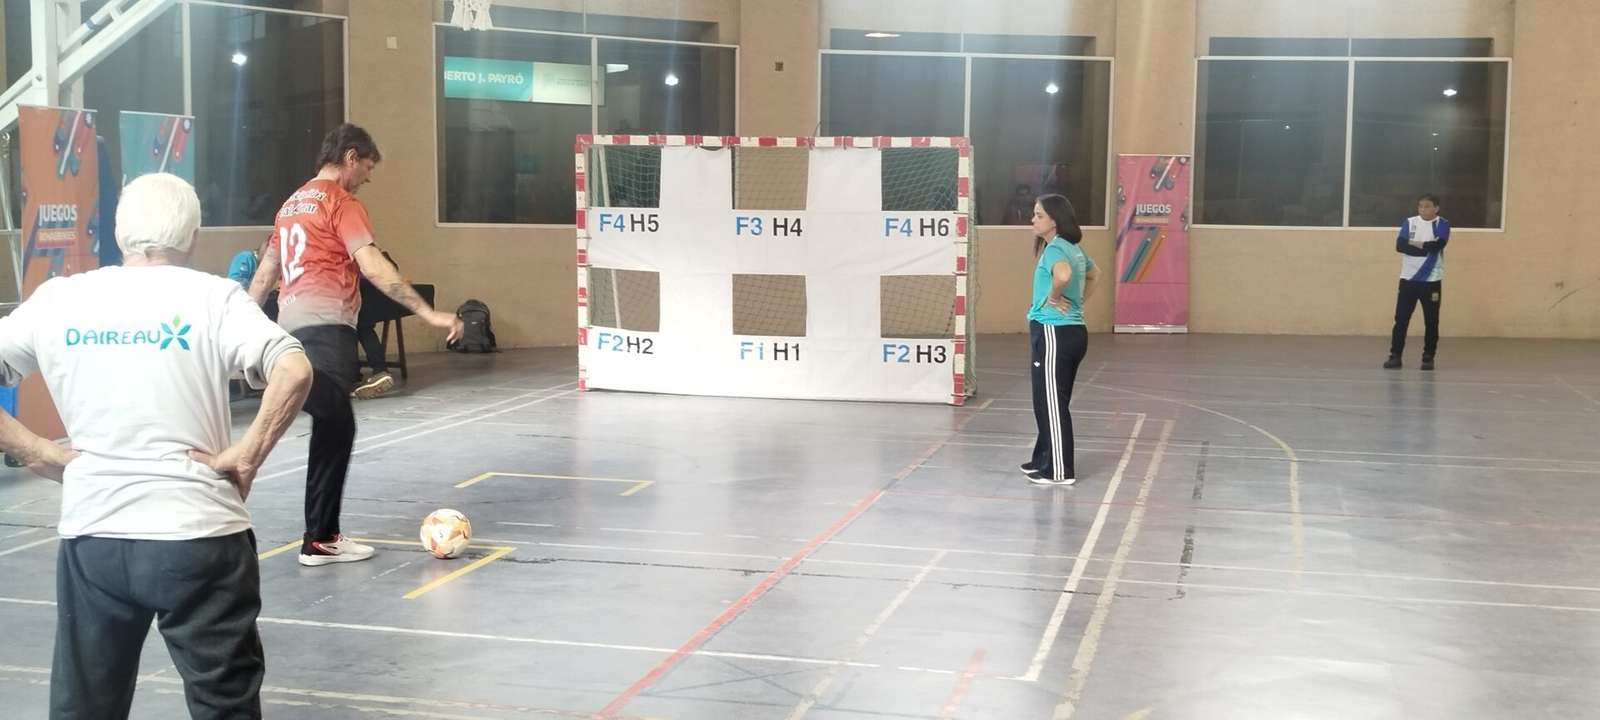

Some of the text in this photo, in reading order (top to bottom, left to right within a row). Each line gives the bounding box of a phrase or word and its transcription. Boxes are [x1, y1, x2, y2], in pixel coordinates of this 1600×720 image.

[488, 72, 524, 85] PAYRÓ
[39, 203, 78, 226] JUEGOS
[1136, 203, 1171, 215] JUEGOS
[599, 213, 660, 233] F4 H5
[736, 216, 803, 237] F3 H4
[885, 218, 949, 237] F4 H6
[280, 223, 306, 286] 12
[598, 332, 654, 355] F2 H2
[773, 342, 800, 361] H1
[882, 343, 947, 364] F2 H3
